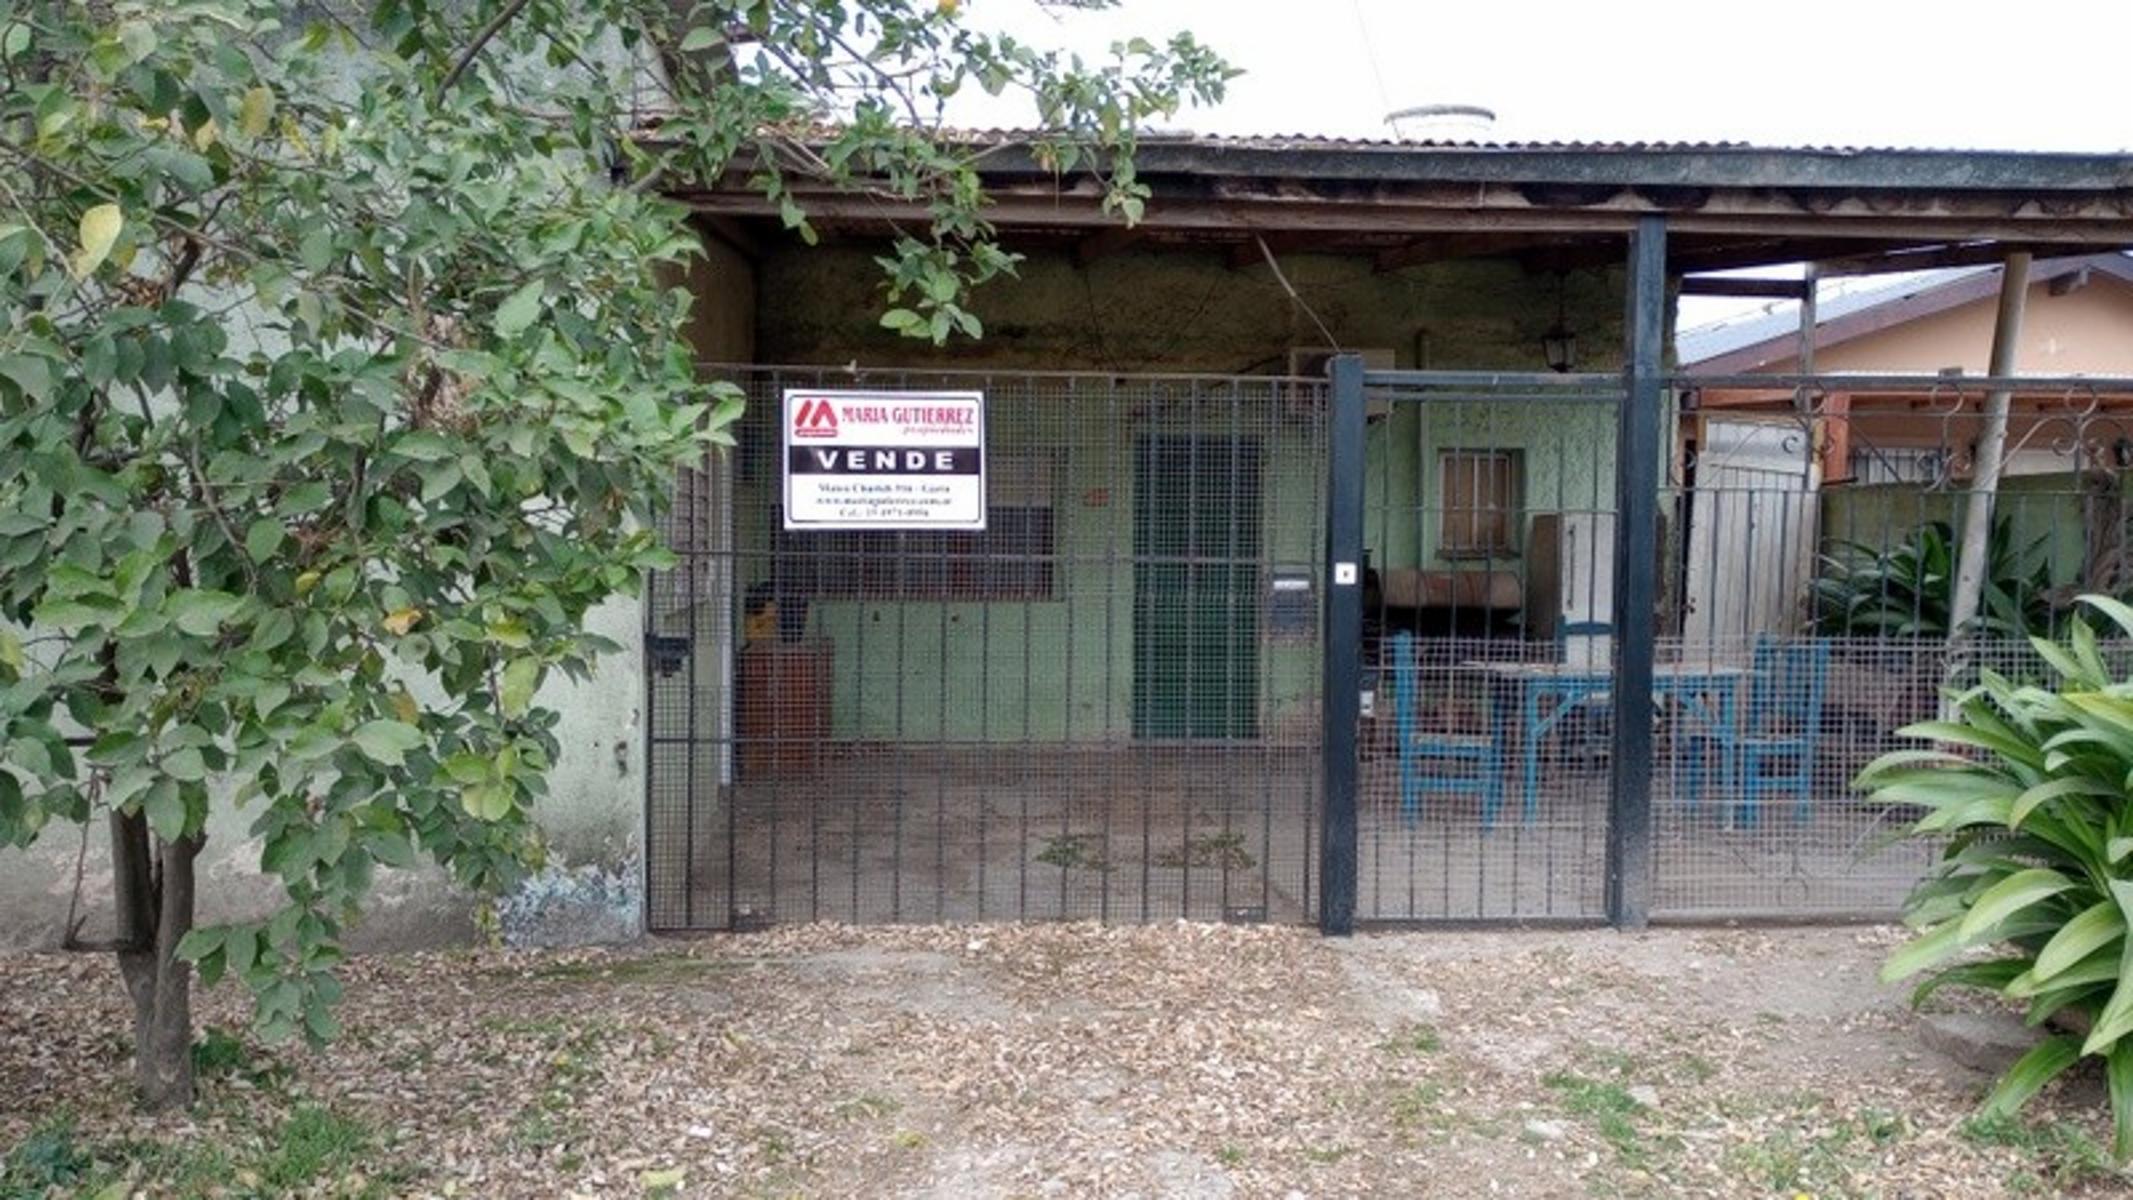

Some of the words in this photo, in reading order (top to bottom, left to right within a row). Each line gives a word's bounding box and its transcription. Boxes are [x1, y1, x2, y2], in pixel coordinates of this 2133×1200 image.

[842, 407, 888, 423] MARIA
[892, 407, 974, 425] GUTIERREZ
[817, 450, 954, 470] VENDE
